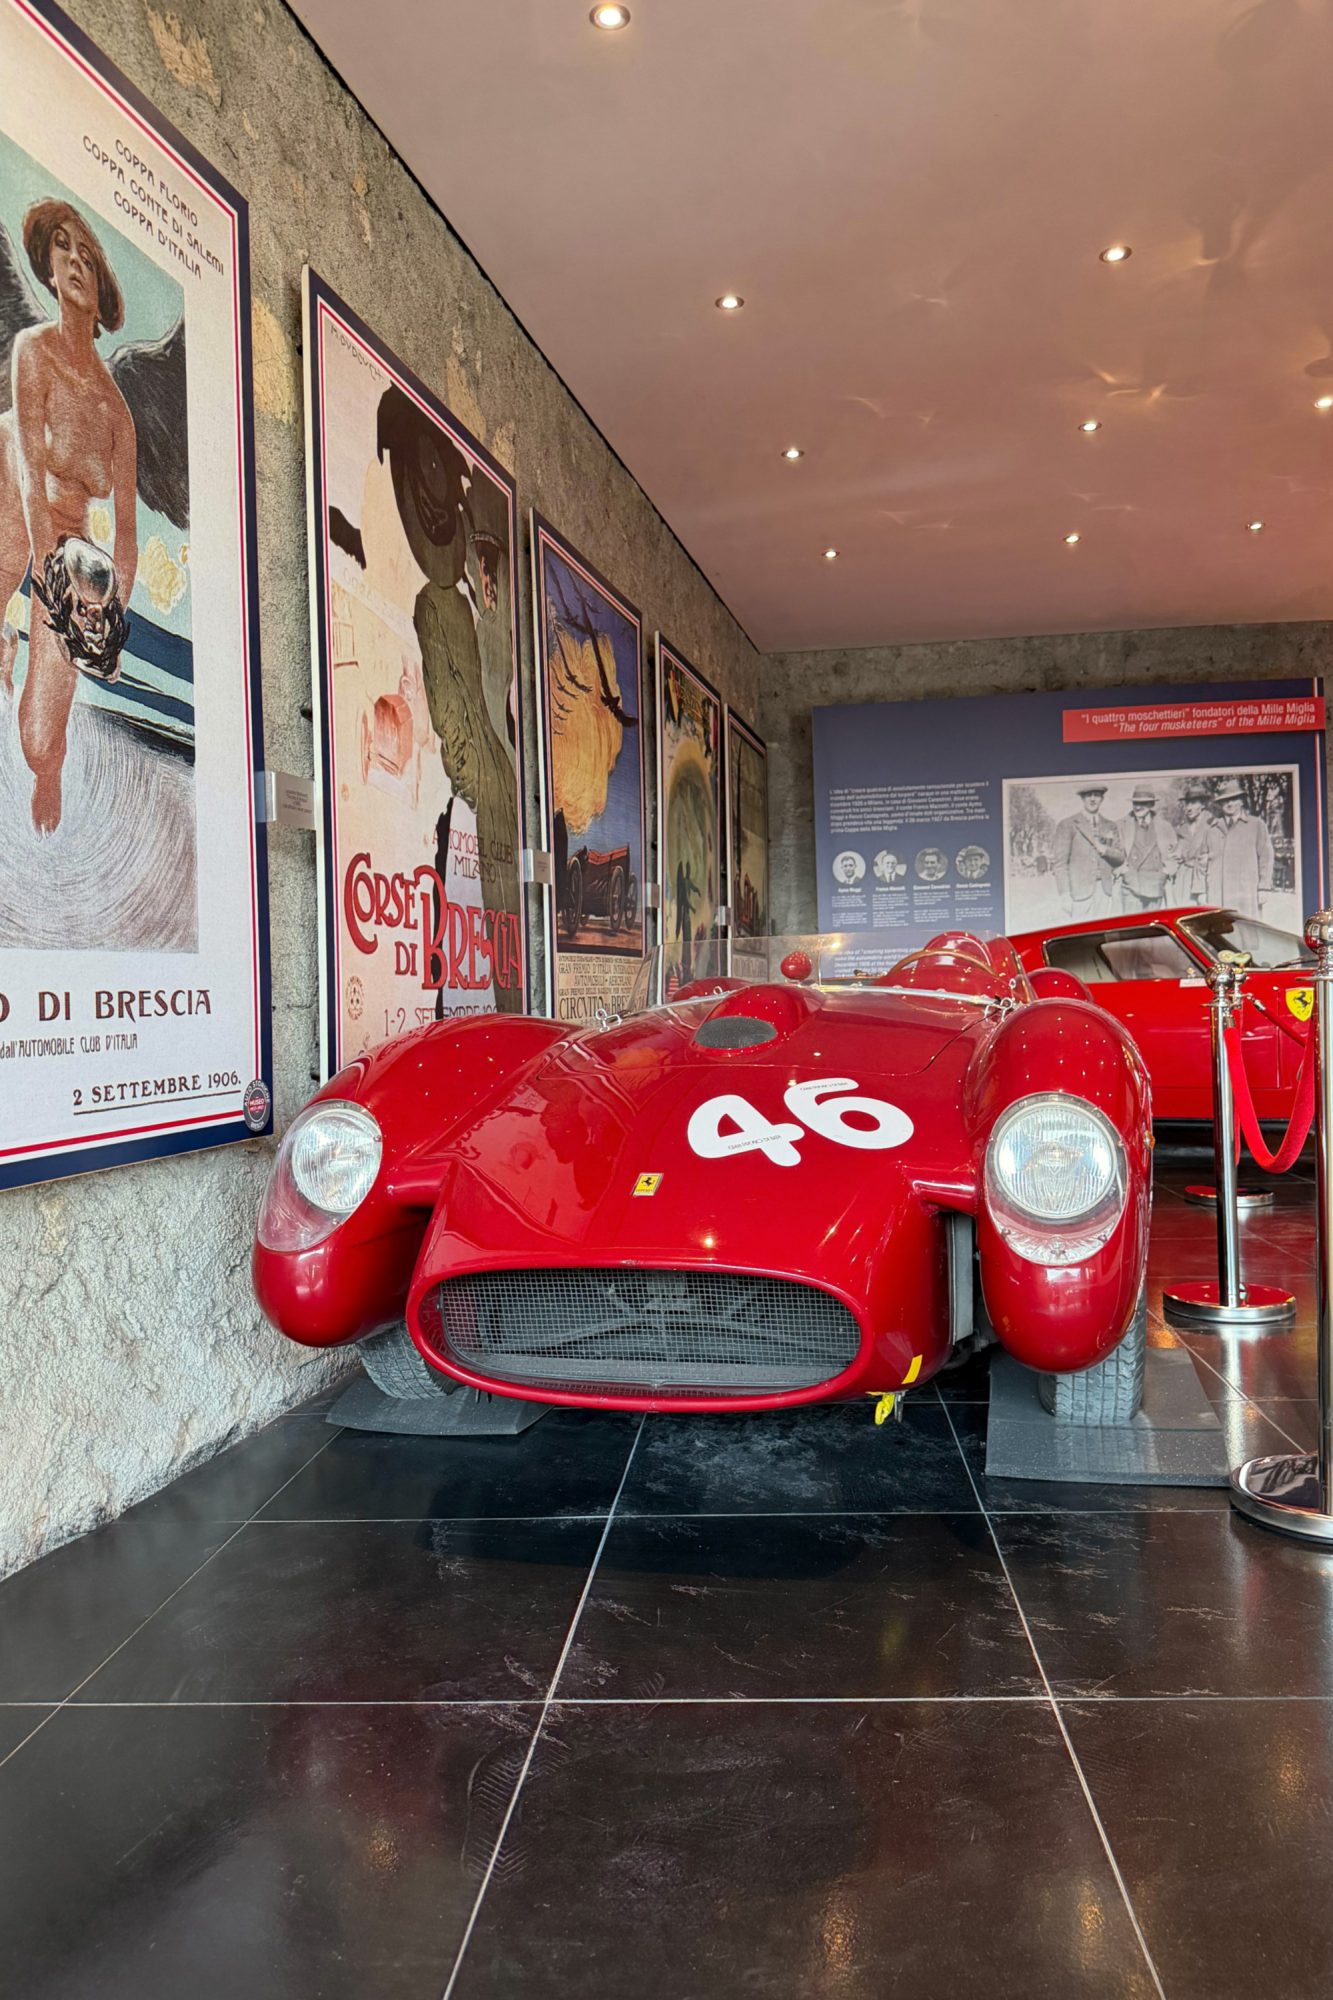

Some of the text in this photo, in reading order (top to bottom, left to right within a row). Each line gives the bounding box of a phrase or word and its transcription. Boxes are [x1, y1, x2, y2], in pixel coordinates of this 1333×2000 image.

[83, 135, 224, 276] COPPA CONTE DI SALEMI
[115, 139, 198, 227] COPPA FLORIO
[114, 191, 202, 280] COPPA D'ITALIA
[1092, 712, 1126, 725] quattro
[1192, 705, 1235, 718] fondatori
[1237, 705, 1259, 716] della
[1261, 703, 1284, 714] Mille
[1286, 702, 1316, 715] Miglia
[1138, 721, 1160, 732] four
[1225, 716, 1237, 728] of
[1238, 716, 1255, 727] the
[1257, 714, 1282, 726] Mille
[1284, 712, 1316, 726] Miglia
[394, 864, 523, 990] DI BRESCIA
[38, 991, 71, 1021] DI
[95, 989, 212, 1024] BRESCIA
[80, 1035, 101, 1053] CLUB
[106, 1033, 138, 1052] D'ITALIA
[73, 1071, 242, 1106] 2 SETTEMBRE 1906.
[687, 1077, 915, 1167] 46
